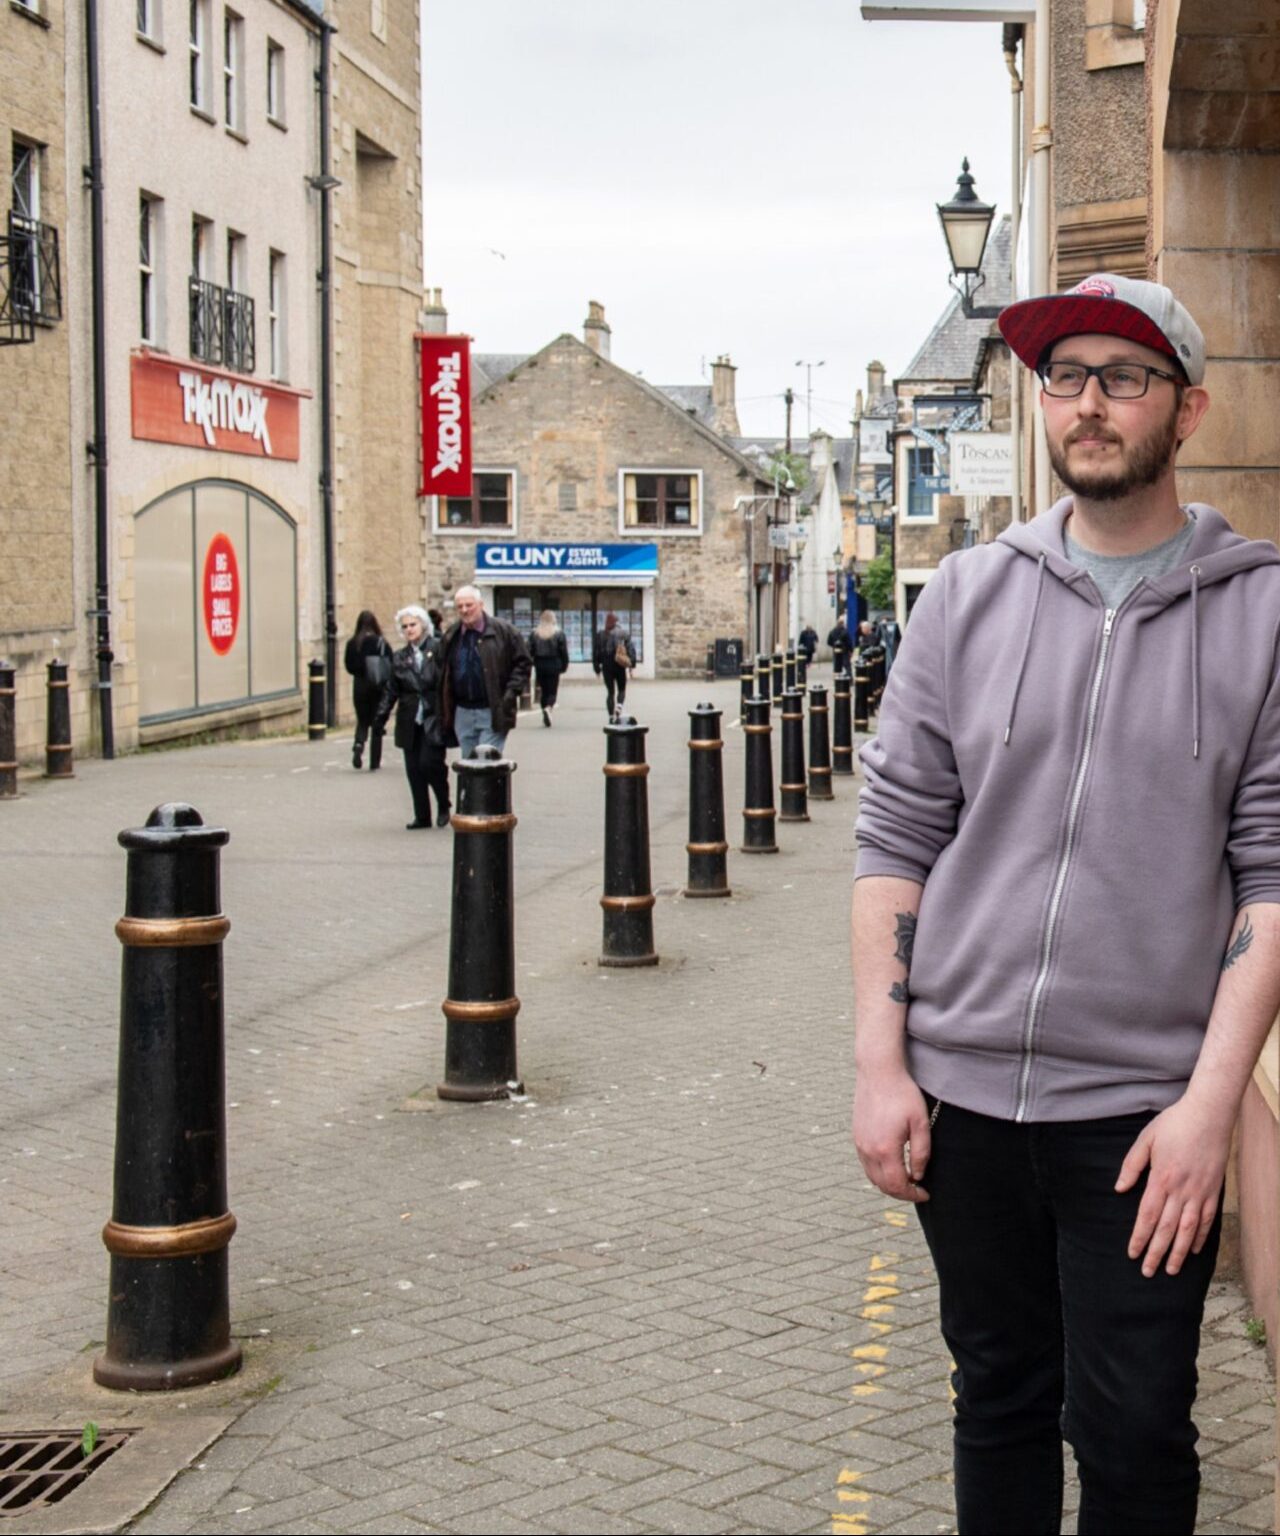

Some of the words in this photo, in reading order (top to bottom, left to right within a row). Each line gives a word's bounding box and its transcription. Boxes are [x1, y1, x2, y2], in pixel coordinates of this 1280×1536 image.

[958, 443, 1012, 460] TOSCAN
[485, 547, 566, 566] CLUNY
[568, 548, 602, 557] ESTATE
[566, 557, 608, 566] AGENTS
